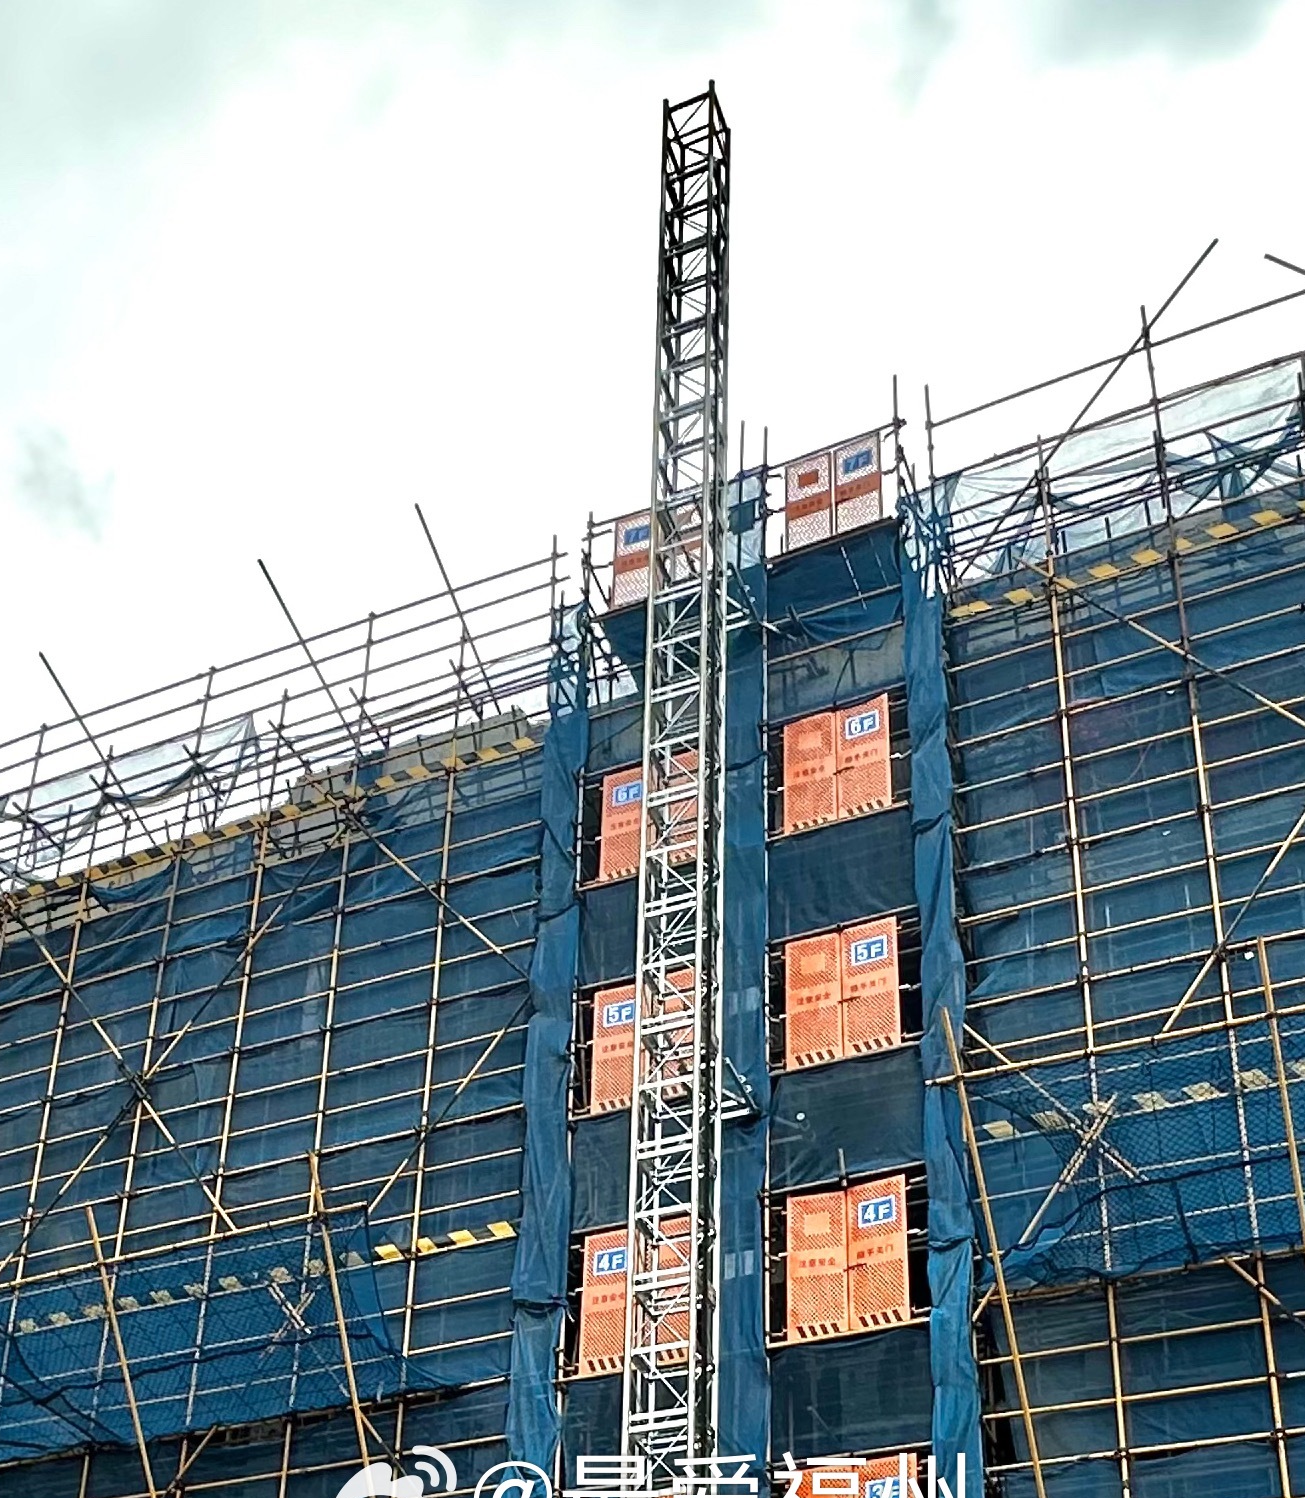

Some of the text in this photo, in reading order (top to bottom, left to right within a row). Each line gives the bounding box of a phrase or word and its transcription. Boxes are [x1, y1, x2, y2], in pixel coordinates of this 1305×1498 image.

[850, 716, 874, 733] 6F
[617, 786, 640, 802] 6F
[856, 942, 882, 960] 5F
[608, 1006, 632, 1022] 5F
[863, 1203, 890, 1222] 4F
[598, 1252, 624, 1271] 4F
